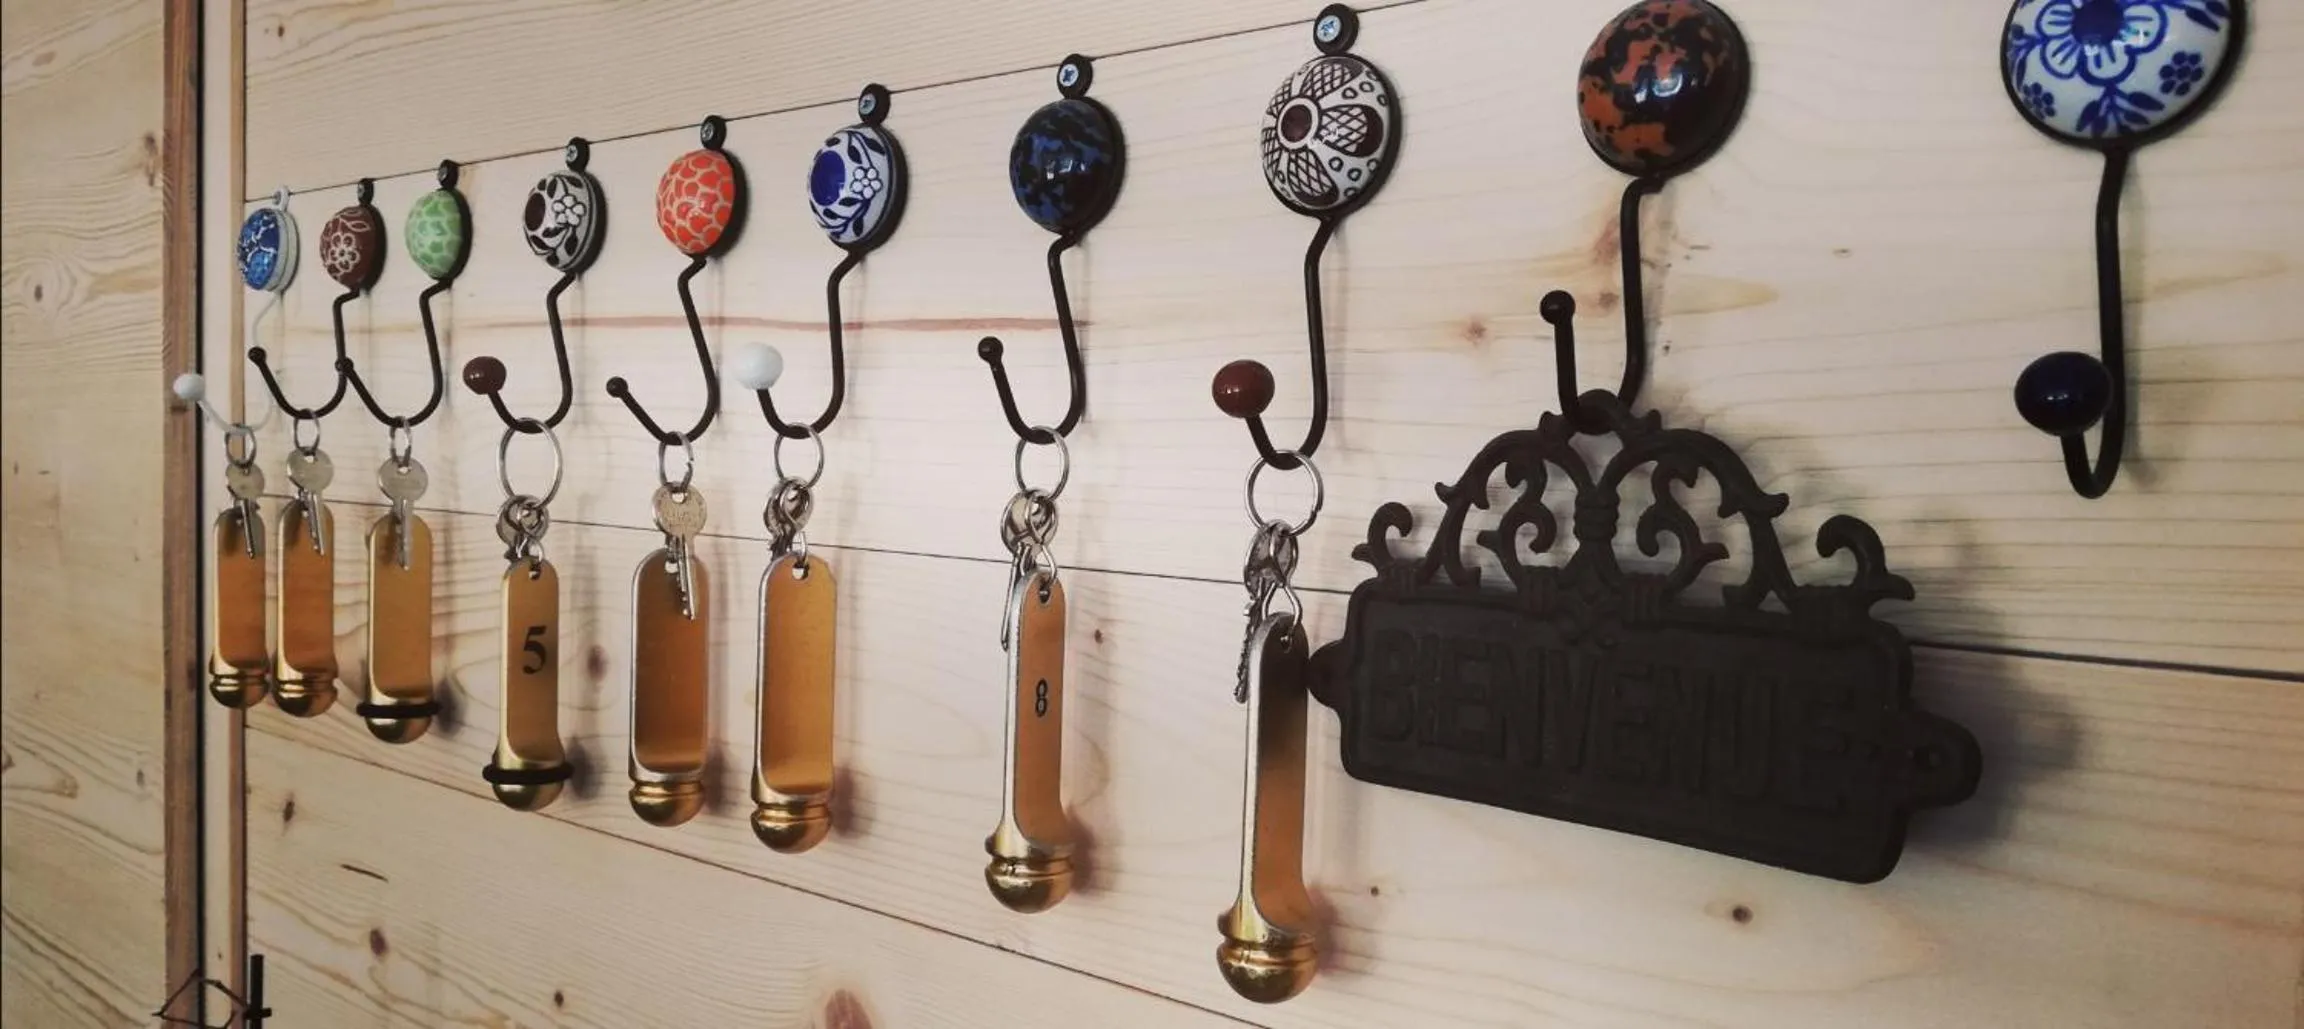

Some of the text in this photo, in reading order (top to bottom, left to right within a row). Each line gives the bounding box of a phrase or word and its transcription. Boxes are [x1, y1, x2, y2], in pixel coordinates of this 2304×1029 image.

[523, 626, 547, 674] 5
[1036, 678, 1048, 717] 8
[1371, 629, 1853, 815] BIENVENUE
